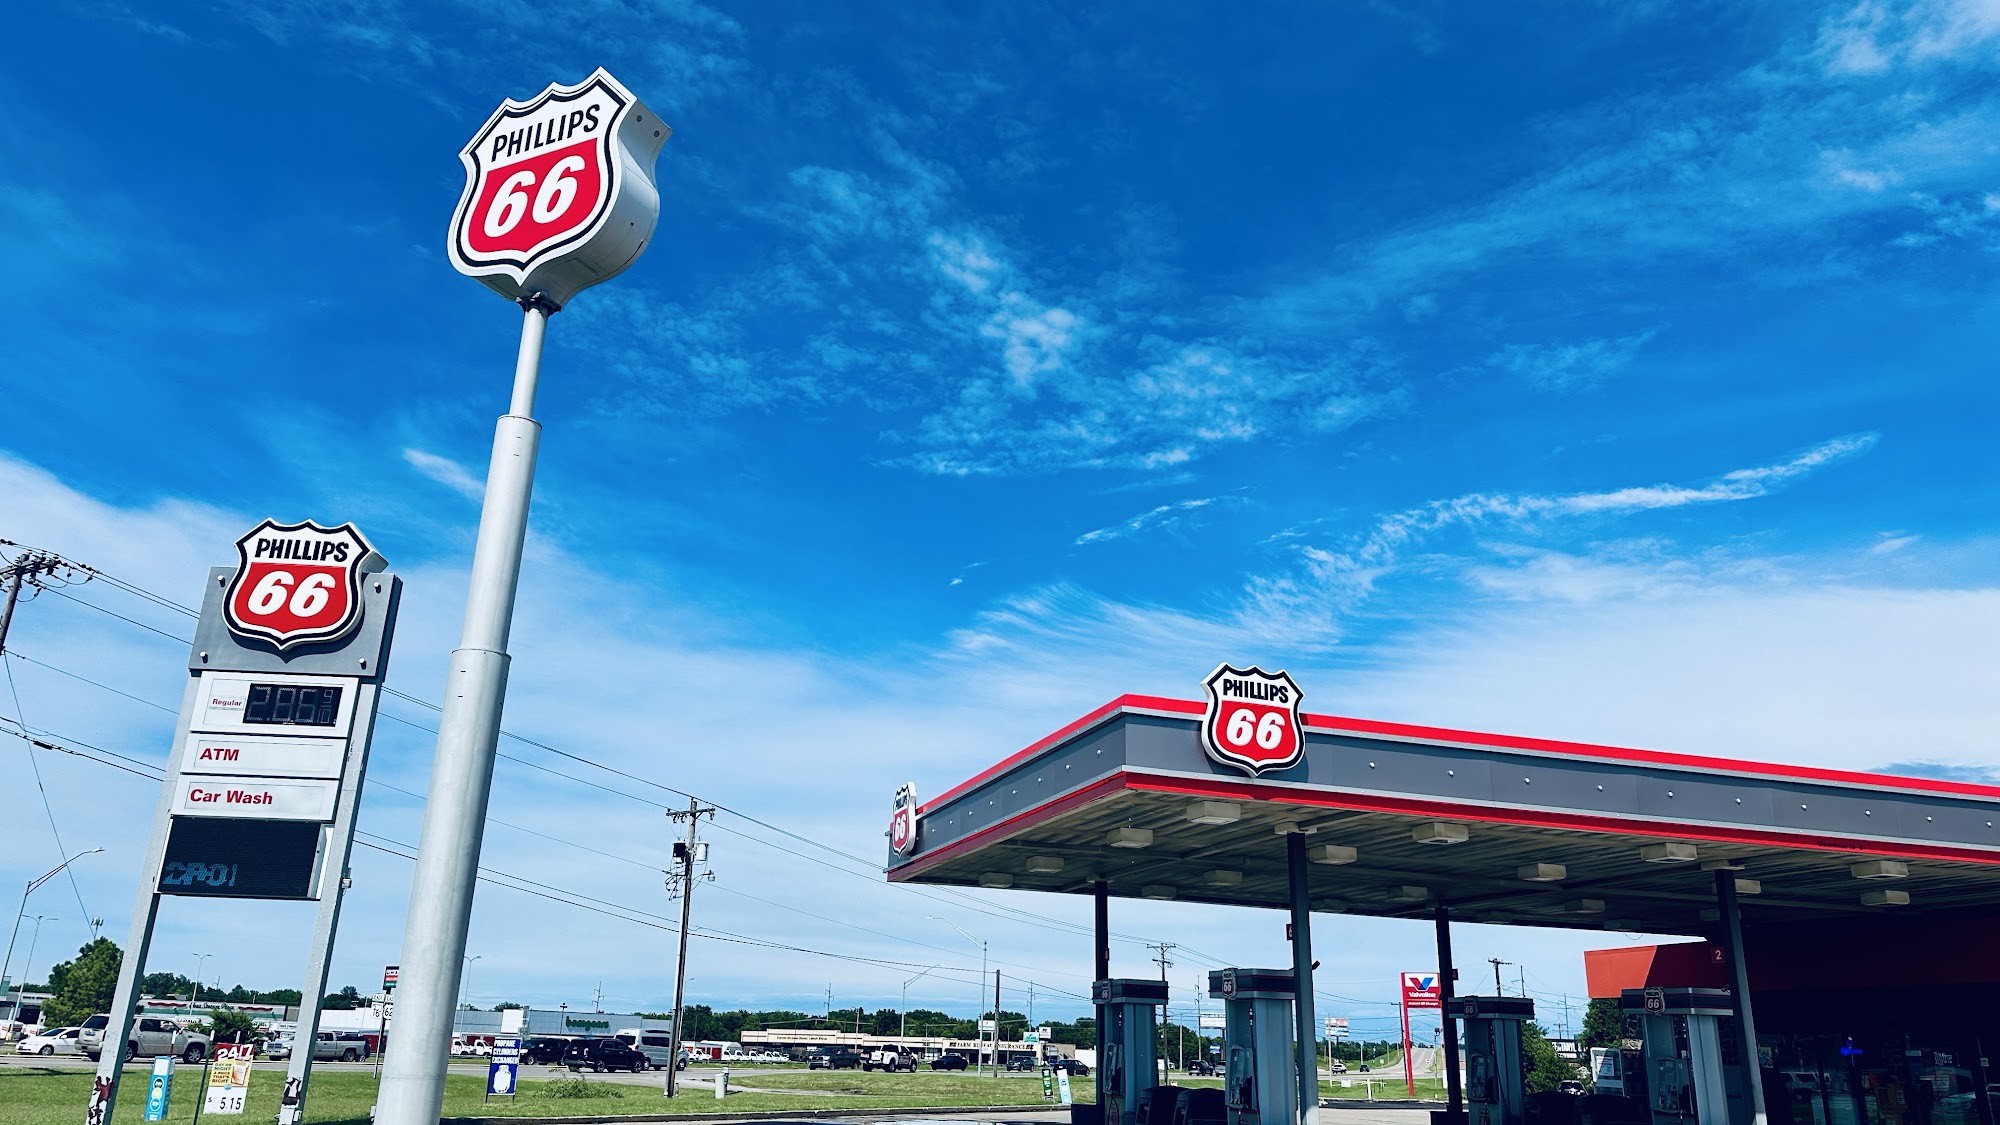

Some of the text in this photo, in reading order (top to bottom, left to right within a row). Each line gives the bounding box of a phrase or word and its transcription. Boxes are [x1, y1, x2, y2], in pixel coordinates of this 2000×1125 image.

[491, 104, 600, 162] PHILLIPS
[484, 155, 586, 238] 66
[255, 538, 349, 562] PHILLIPS
[248, 570, 336, 617] 66
[1223, 679, 1288, 703] PHILLIPS
[212, 698, 242, 706] Regular
[1226, 708, 1285, 750] 66
[200, 748, 239, 761] ATM
[190, 789, 273, 805] Car Wash
[895, 813, 906, 842] 66
[1715, 950, 1722, 960] 2
[1224, 981, 1231, 992] 66
[1465, 1005, 1474, 1013] 66
[1648, 999, 1660, 1008] 66
